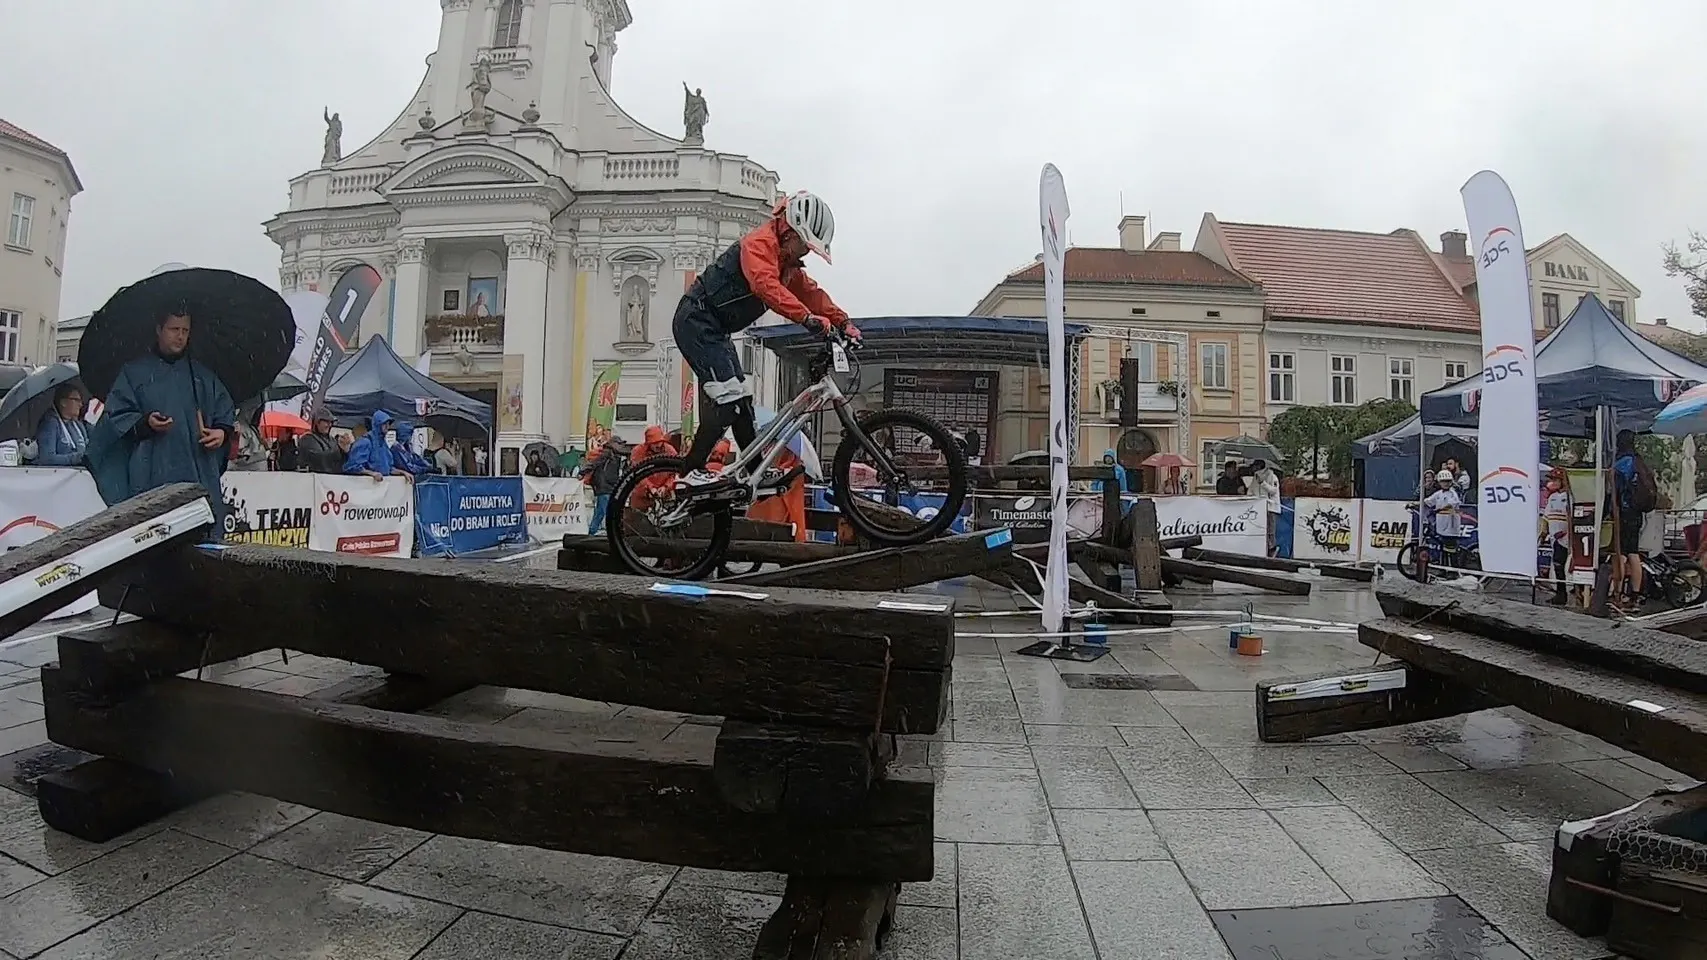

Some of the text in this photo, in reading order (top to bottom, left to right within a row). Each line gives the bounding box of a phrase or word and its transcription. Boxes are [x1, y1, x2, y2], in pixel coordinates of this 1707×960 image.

[1544, 261, 1589, 281] BANK
[338, 288, 358, 324] 1
[310, 346, 333, 393] GAMES
[343, 502, 409, 522] rowerowa.pl
[460, 495, 513, 510] AUTOMATYKA
[256, 507, 311, 531] TEAM
[451, 517, 464, 531] DO
[466, 515, 490, 530] BRAM
[496, 513, 521, 527] ROLET
[990, 508, 1053, 520] Timemaste
[1371, 521, 1408, 535] EAM
[1581, 535, 1589, 557] 1
